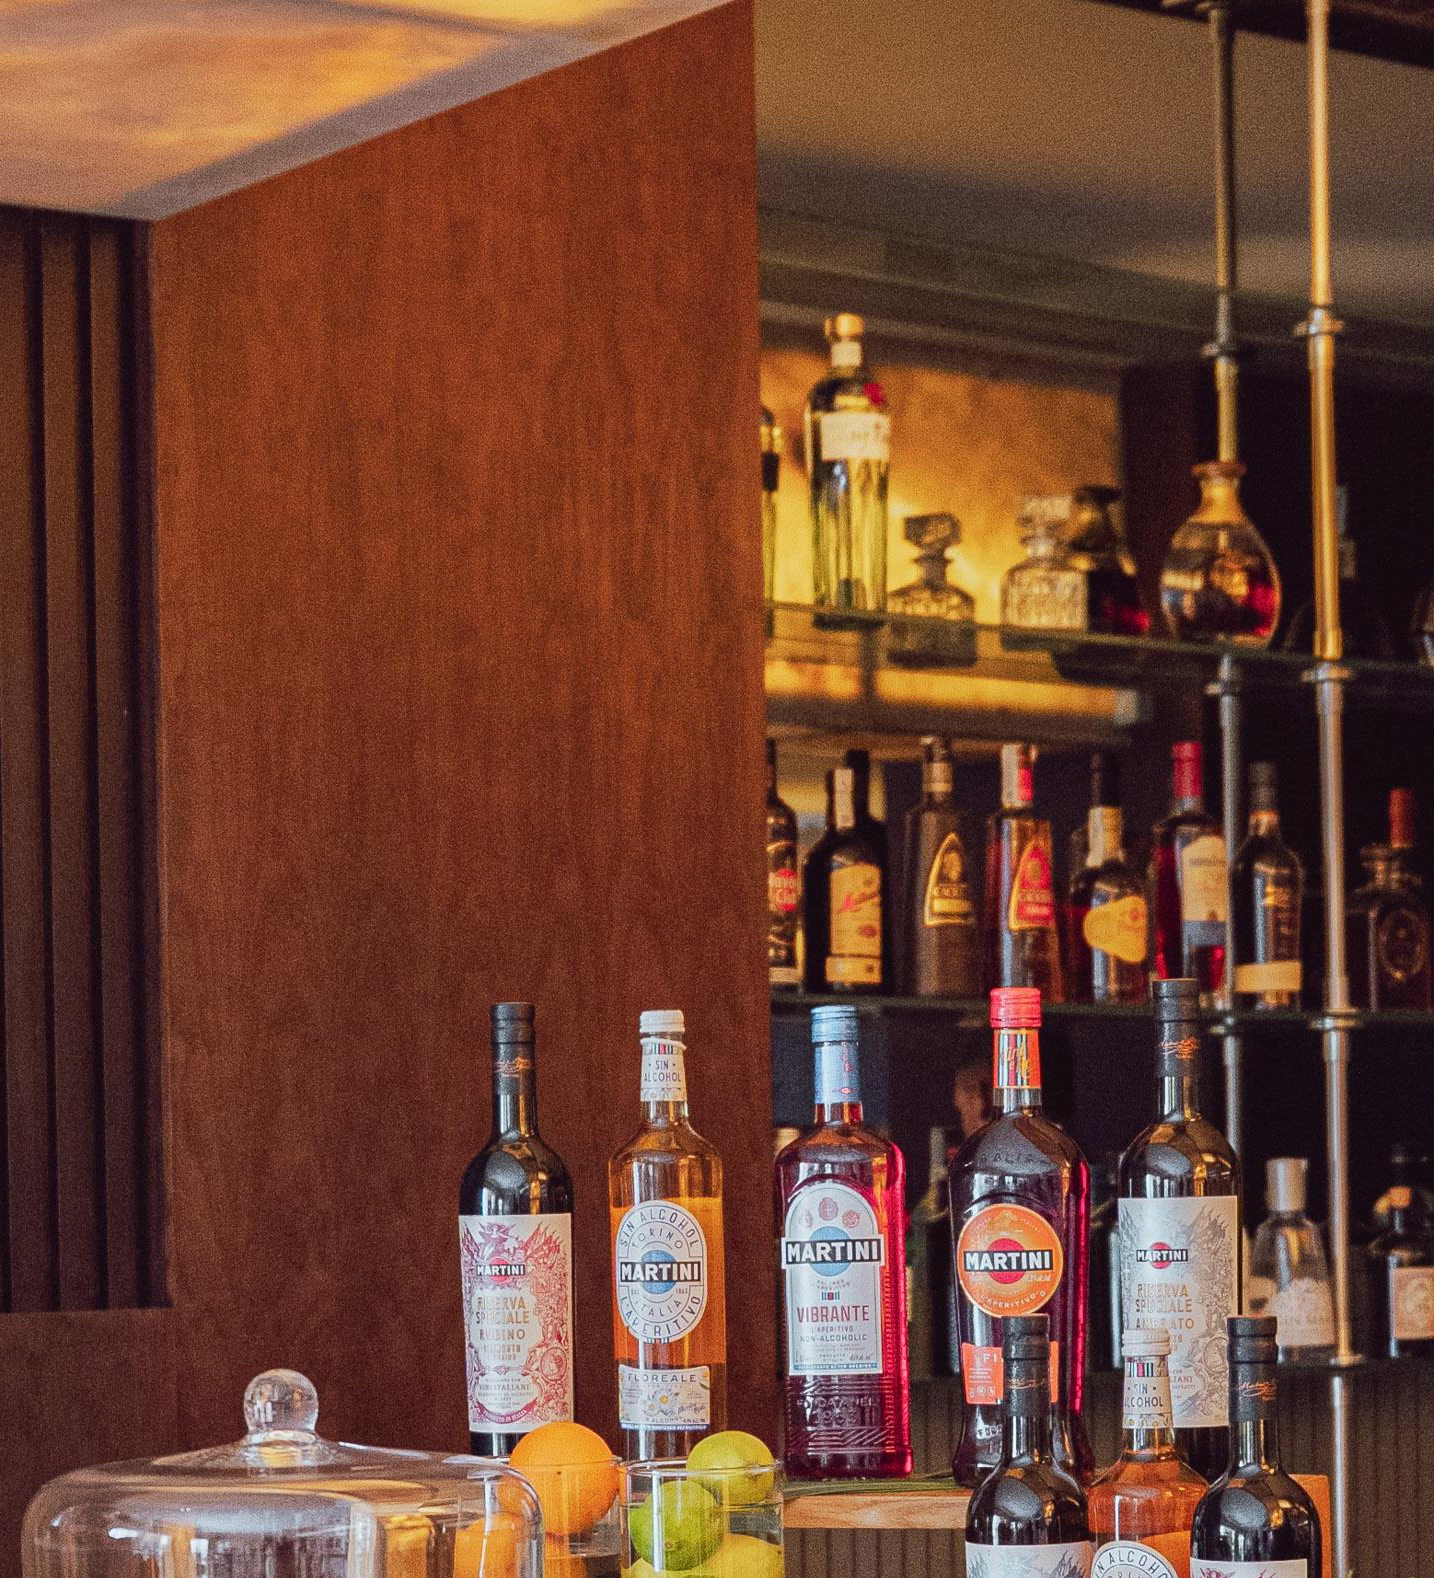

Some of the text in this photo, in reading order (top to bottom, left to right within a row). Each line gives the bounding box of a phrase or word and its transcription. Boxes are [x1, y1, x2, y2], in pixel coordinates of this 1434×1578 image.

[655, 1060, 669, 1070] SIN
[644, 1072, 682, 1082] ALCOHOL
[620, 1208, 700, 1248] SIN ALCOHOL
[631, 1227, 684, 1249] TORINO
[787, 1241, 878, 1263] MARTINI
[1137, 1250, 1188, 1262] MARTINI
[965, 1251, 1051, 1271] MARTINI
[476, 1264, 525, 1277] MARTINI
[621, 1263, 699, 1281] MARTINI
[1137, 1283, 1189, 1297] RISERVA
[477, 1296, 526, 1310] RISERVA
[1136, 1299, 1193, 1313] SPECIALE
[476, 1310, 530, 1325] SPECIALE
[797, 1305, 870, 1323] VIBRANTE
[1136, 1317, 1195, 1330] AMBRATO
[479, 1328, 526, 1341] RUBINO
[800, 1334, 868, 1343] NON-ALCOHOLIC
[628, 1373, 697, 1382] FLOREALE
[494, 1383, 531, 1391] ITALIANI
[1133, 1384, 1148, 1394] SIN
